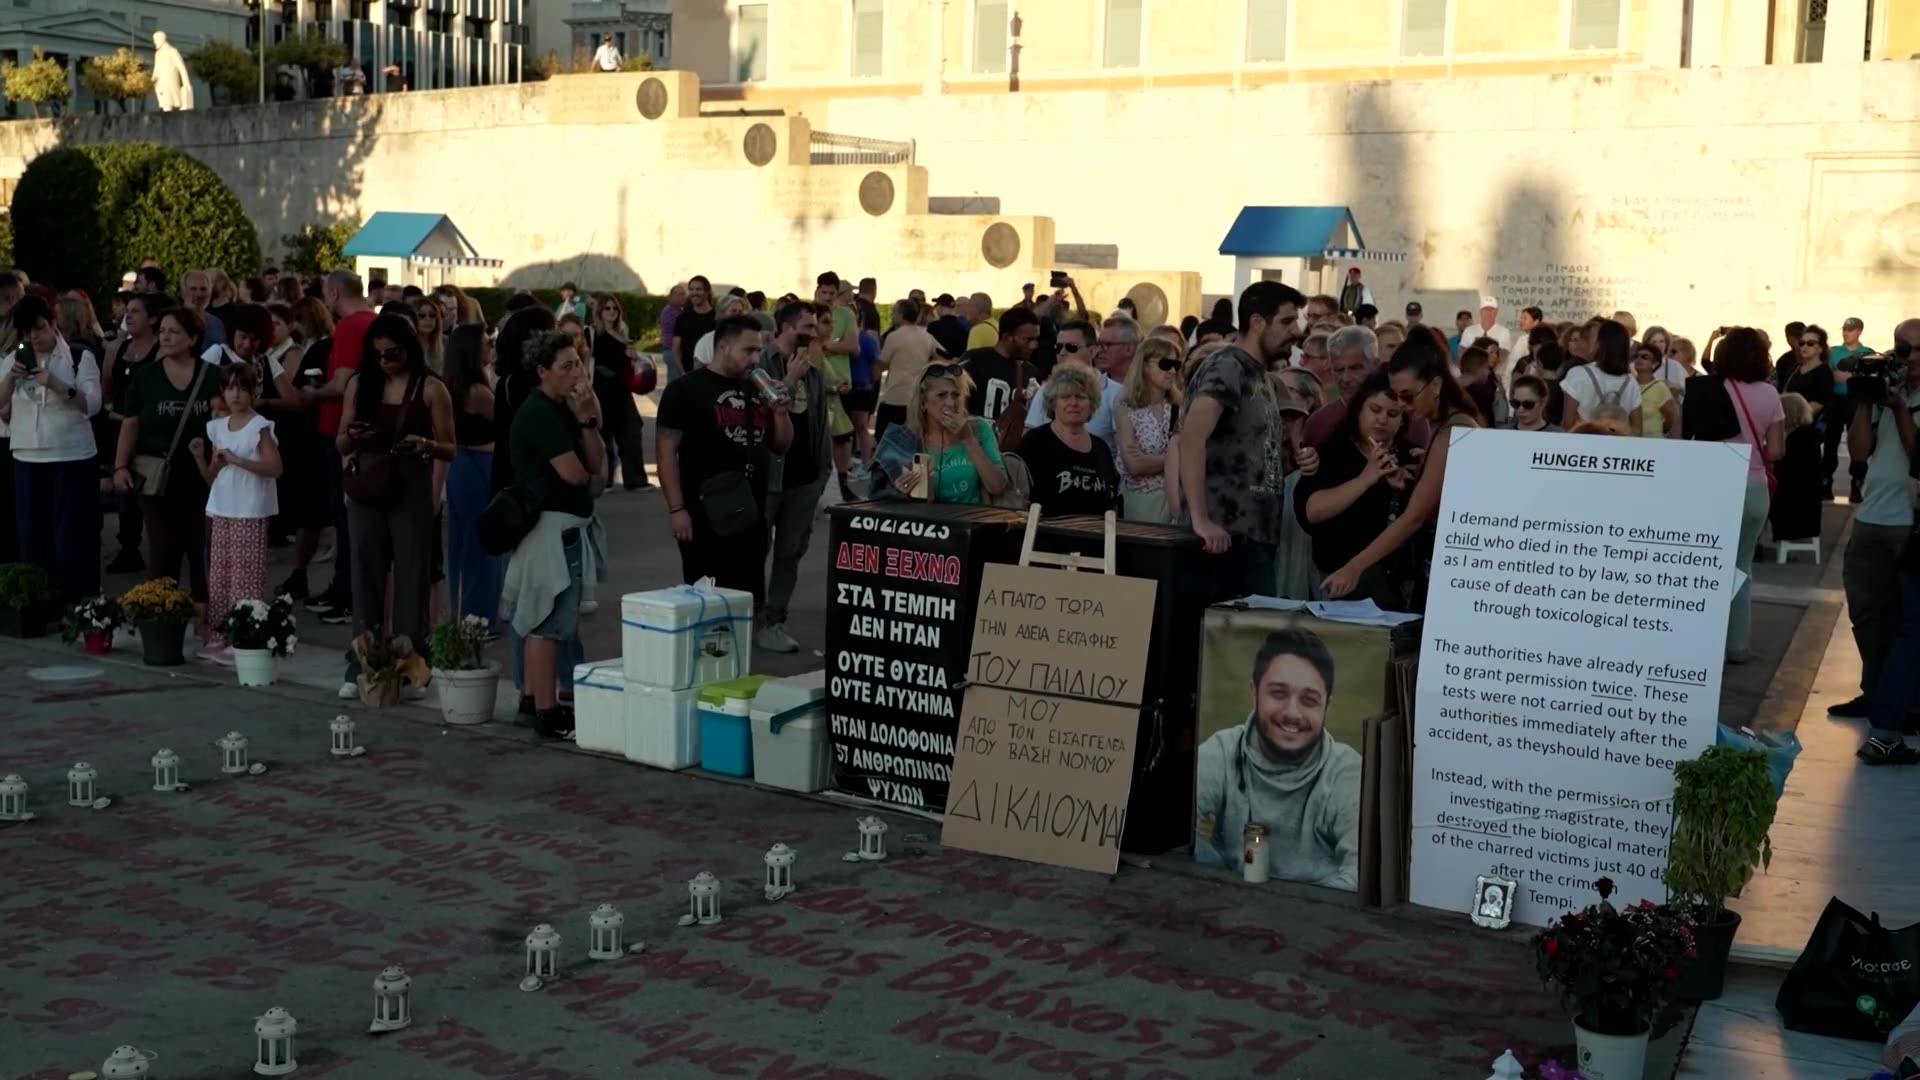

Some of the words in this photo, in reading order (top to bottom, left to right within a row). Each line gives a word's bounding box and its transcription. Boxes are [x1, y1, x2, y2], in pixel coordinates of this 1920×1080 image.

[1532, 452, 1598, 468] HUNGER
[1602, 457, 1655, 472] STRIKE
[1452, 511, 1455, 523] I
[1460, 512, 1519, 528] demand
[1523, 520, 1603, 535] permission
[1609, 524, 1624, 537] to
[1629, 526, 1691, 542] exhume
[1696, 533, 1719, 549] my
[836, 542, 880, 574] ΔΕΝ
[885, 547, 961, 585] ΞΕΧΝΩ
[1446, 532, 1479, 546] child
[1484, 536, 1514, 549] who
[1519, 538, 1550, 552] died
[1555, 541, 1568, 554] in
[1574, 543, 1598, 557] the
[1603, 545, 1648, 563] Tempi
[1652, 551, 1722, 570] accident,
[1444, 556, 1458, 566] as
[1463, 555, 1467, 567] I
[1471, 559, 1493, 569] am
[1498, 560, 1554, 575] entitled
[1560, 565, 1574, 577] to
[1579, 564, 1597, 582] by
[1601, 567, 1629, 584] law,
[1635, 573, 1651, 584] so
[1657, 572, 1688, 587] that
[1693, 576, 1719, 590] the
[838, 583, 875, 608] ΣΤΑ
[882, 590, 955, 620] ΤΕΜΠΗ
[1055, 597, 1105, 617] ΤΩΡΑ
[1450, 578, 1490, 591] cause
[1495, 580, 1511, 592] of
[1514, 581, 1556, 598] death
[1561, 589, 1586, 600] can
[1592, 588, 1609, 603] be
[1615, 591, 1705, 612] determined
[850, 614, 884, 639] ΔΕΝ
[890, 621, 940, 648] ΗΤΑΝ
[979, 618, 1007, 637] ΤΗΝ
[1015, 623, 1050, 642] ΑΔΕΙΑ
[1057, 628, 1120, 649] ΕΚΤΑΦΗΣ
[1474, 600, 1530, 619] through
[1536, 607, 1628, 628] toxicological
[1633, 617, 1672, 632] tests.
[838, 651, 884, 678] ΟΥΤΕ
[891, 660, 947, 689] ΘΥΣΙΑ
[972, 651, 1022, 685] ΤΟΥ
[1029, 662, 1128, 699] ΠΑΙΔΙΟΥ
[1434, 639, 1460, 653] The
[1464, 644, 1542, 663] authorities
[1547, 651, 1582, 668] have
[1587, 656, 1643, 677] already
[1648, 664, 1707, 682] refused
[831, 677, 870, 703] ΟΥΤΕ
[875, 685, 954, 717] ΑΤΥΧΗΜΑ
[1446, 664, 1460, 675] to
[1464, 667, 1502, 681] grant
[1506, 672, 1587, 691] permission
[1592, 680, 1636, 697] twice.
[1644, 685, 1688, 703] These
[1007, 695, 1061, 723] ΜΟΥ
[1443, 685, 1476, 700] tests
[1481, 692, 1516, 704] were
[1521, 697, 1545, 708] not
[1550, 700, 1603, 716] carried
[1608, 707, 1633, 720] out
[1639, 707, 1656, 725] by
[1662, 711, 1687, 726] the
[832, 714, 866, 739] ΗΤΑΝ
[870, 723, 955, 754] ΔΟΛΟΦΟΝΙΑ
[968, 715, 996, 736] ΑΠΟ
[1008, 723, 1035, 740] ΤΟΝ
[1429, 728, 1492, 747] accident,
[1497, 737, 1512, 748] as
[1517, 737, 1599, 760] theyshould
[1605, 748, 1640, 765] have
[1440, 707, 1518, 727] authorities
[1523, 715, 1616, 742] immediately
[1620, 729, 1657, 744] after
[1662, 734, 1687, 749] the
[836, 743, 848, 763] 57
[962, 735, 997, 756] ΠΟΥ
[1008, 742, 1050, 765] ΒΑΣΗ
[1059, 751, 1116, 774] ΝΟΜΟΥ
[868, 778, 923, 806] ΨΥΧΩΝ
[1432, 768, 1486, 789] Instead,
[1492, 778, 1523, 792] with
[1529, 782, 1552, 797] the
[1558, 789, 1640, 810] permission
[1645, 800, 1662, 812] of
[1451, 792, 1540, 820] investigating
[1545, 804, 1628, 832] magistrate,
[1635, 819, 1668, 838] they
[1437, 812, 1508, 834] destroyed
[1512, 824, 1536, 837] the
[1541, 827, 1611, 849] biological
[1617, 842, 1666, 857] materi
[1432, 832, 1446, 844] of
[1451, 835, 1473, 849] the
[1478, 839, 1533, 859] charred
[1538, 849, 1589, 868] victims
[1594, 857, 1621, 873] just
[1627, 863, 1645, 877] 40
[1650, 867, 1668, 879] da
[1491, 863, 1524, 881] after
[1530, 869, 1553, 883] the
[1528, 890, 1576, 909] Tempi.
